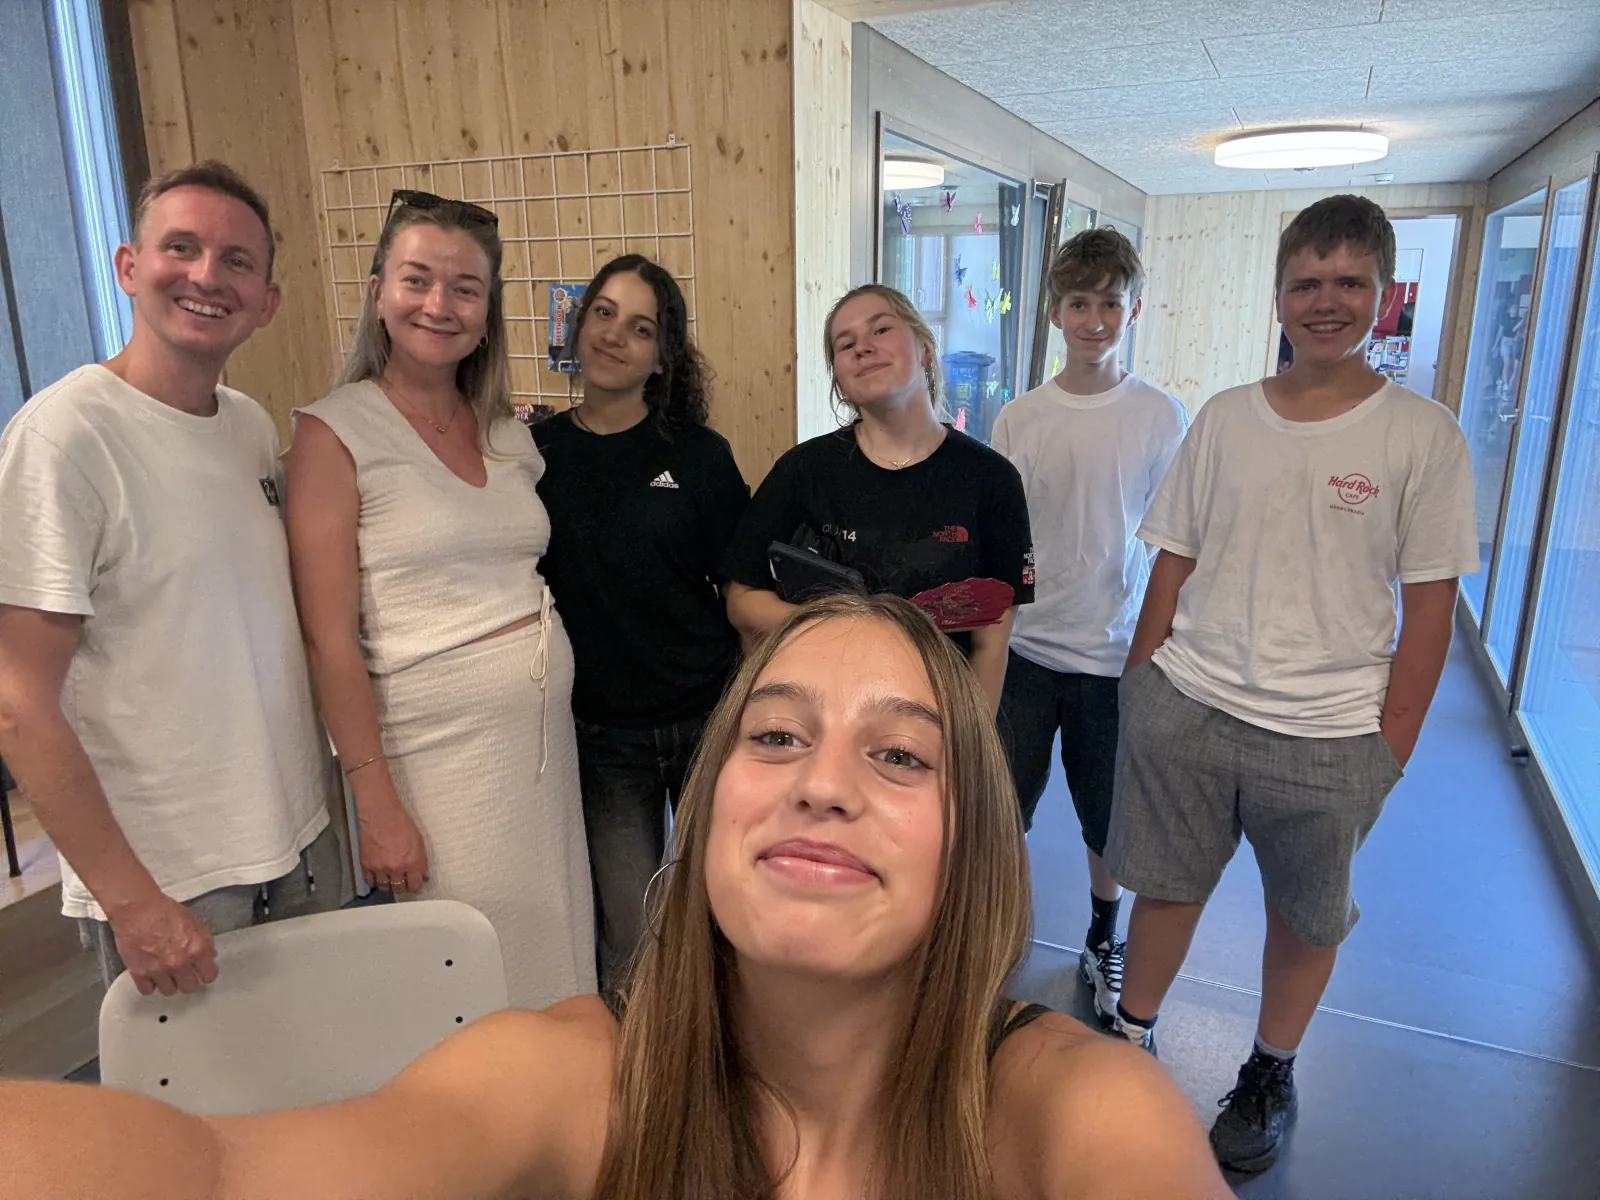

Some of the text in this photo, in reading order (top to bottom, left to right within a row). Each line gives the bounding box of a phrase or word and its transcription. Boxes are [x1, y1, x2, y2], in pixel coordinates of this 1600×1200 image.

[649, 480, 680, 489] adidas
[1327, 475, 1380, 498] Hard Rock
[1345, 492, 1360, 500] CAFE
